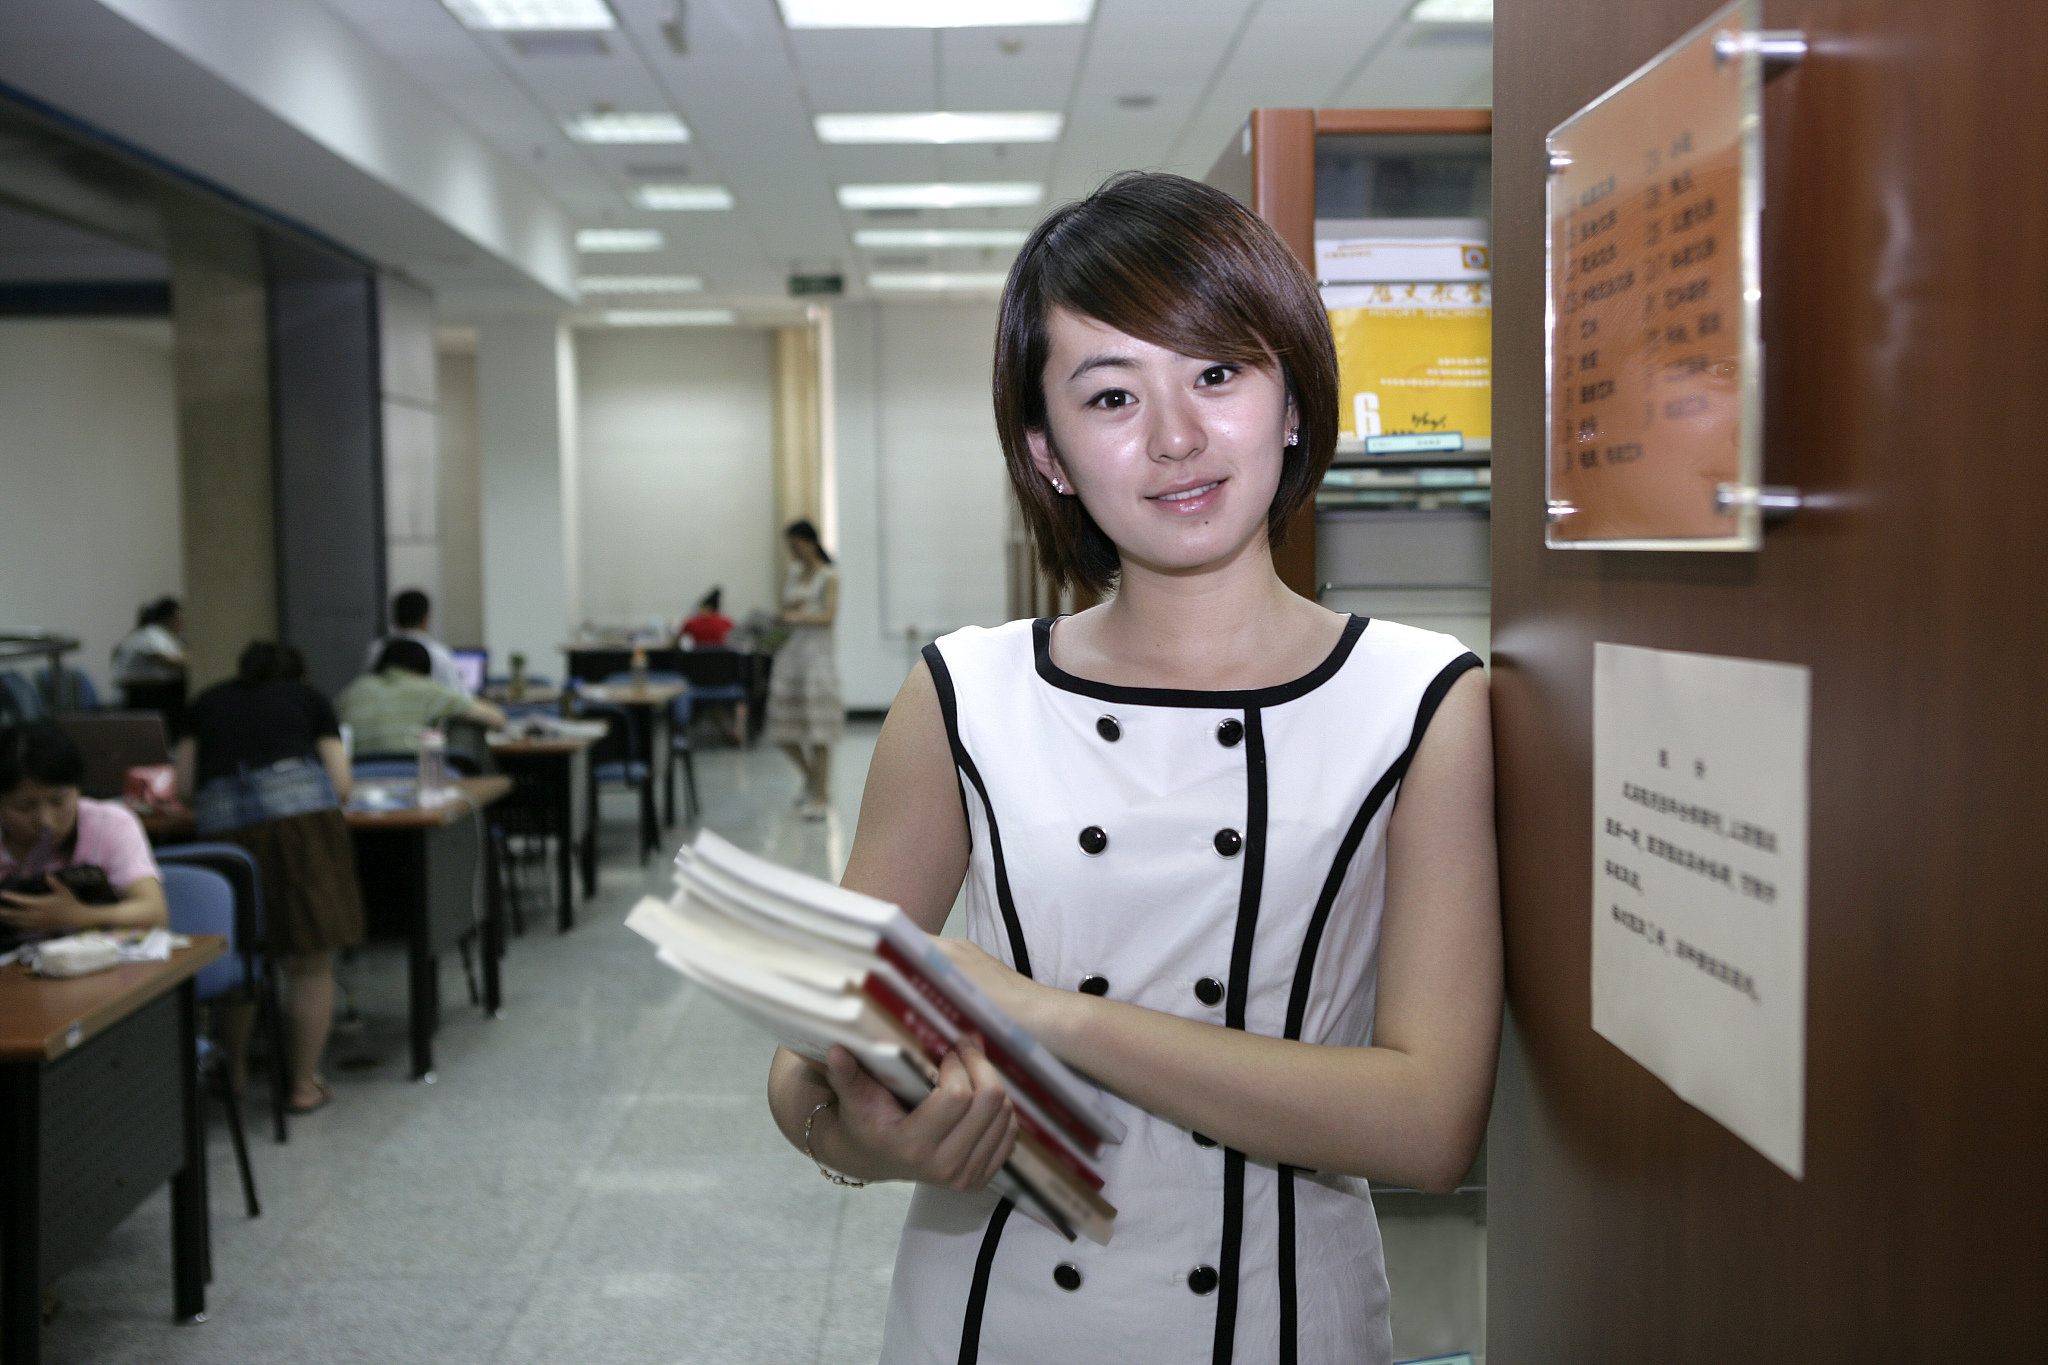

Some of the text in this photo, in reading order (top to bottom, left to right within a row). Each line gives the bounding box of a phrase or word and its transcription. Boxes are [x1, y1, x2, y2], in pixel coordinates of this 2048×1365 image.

[1368, 308, 1488, 320] HISTORY TEACHING
[1354, 392, 1381, 439] 6
